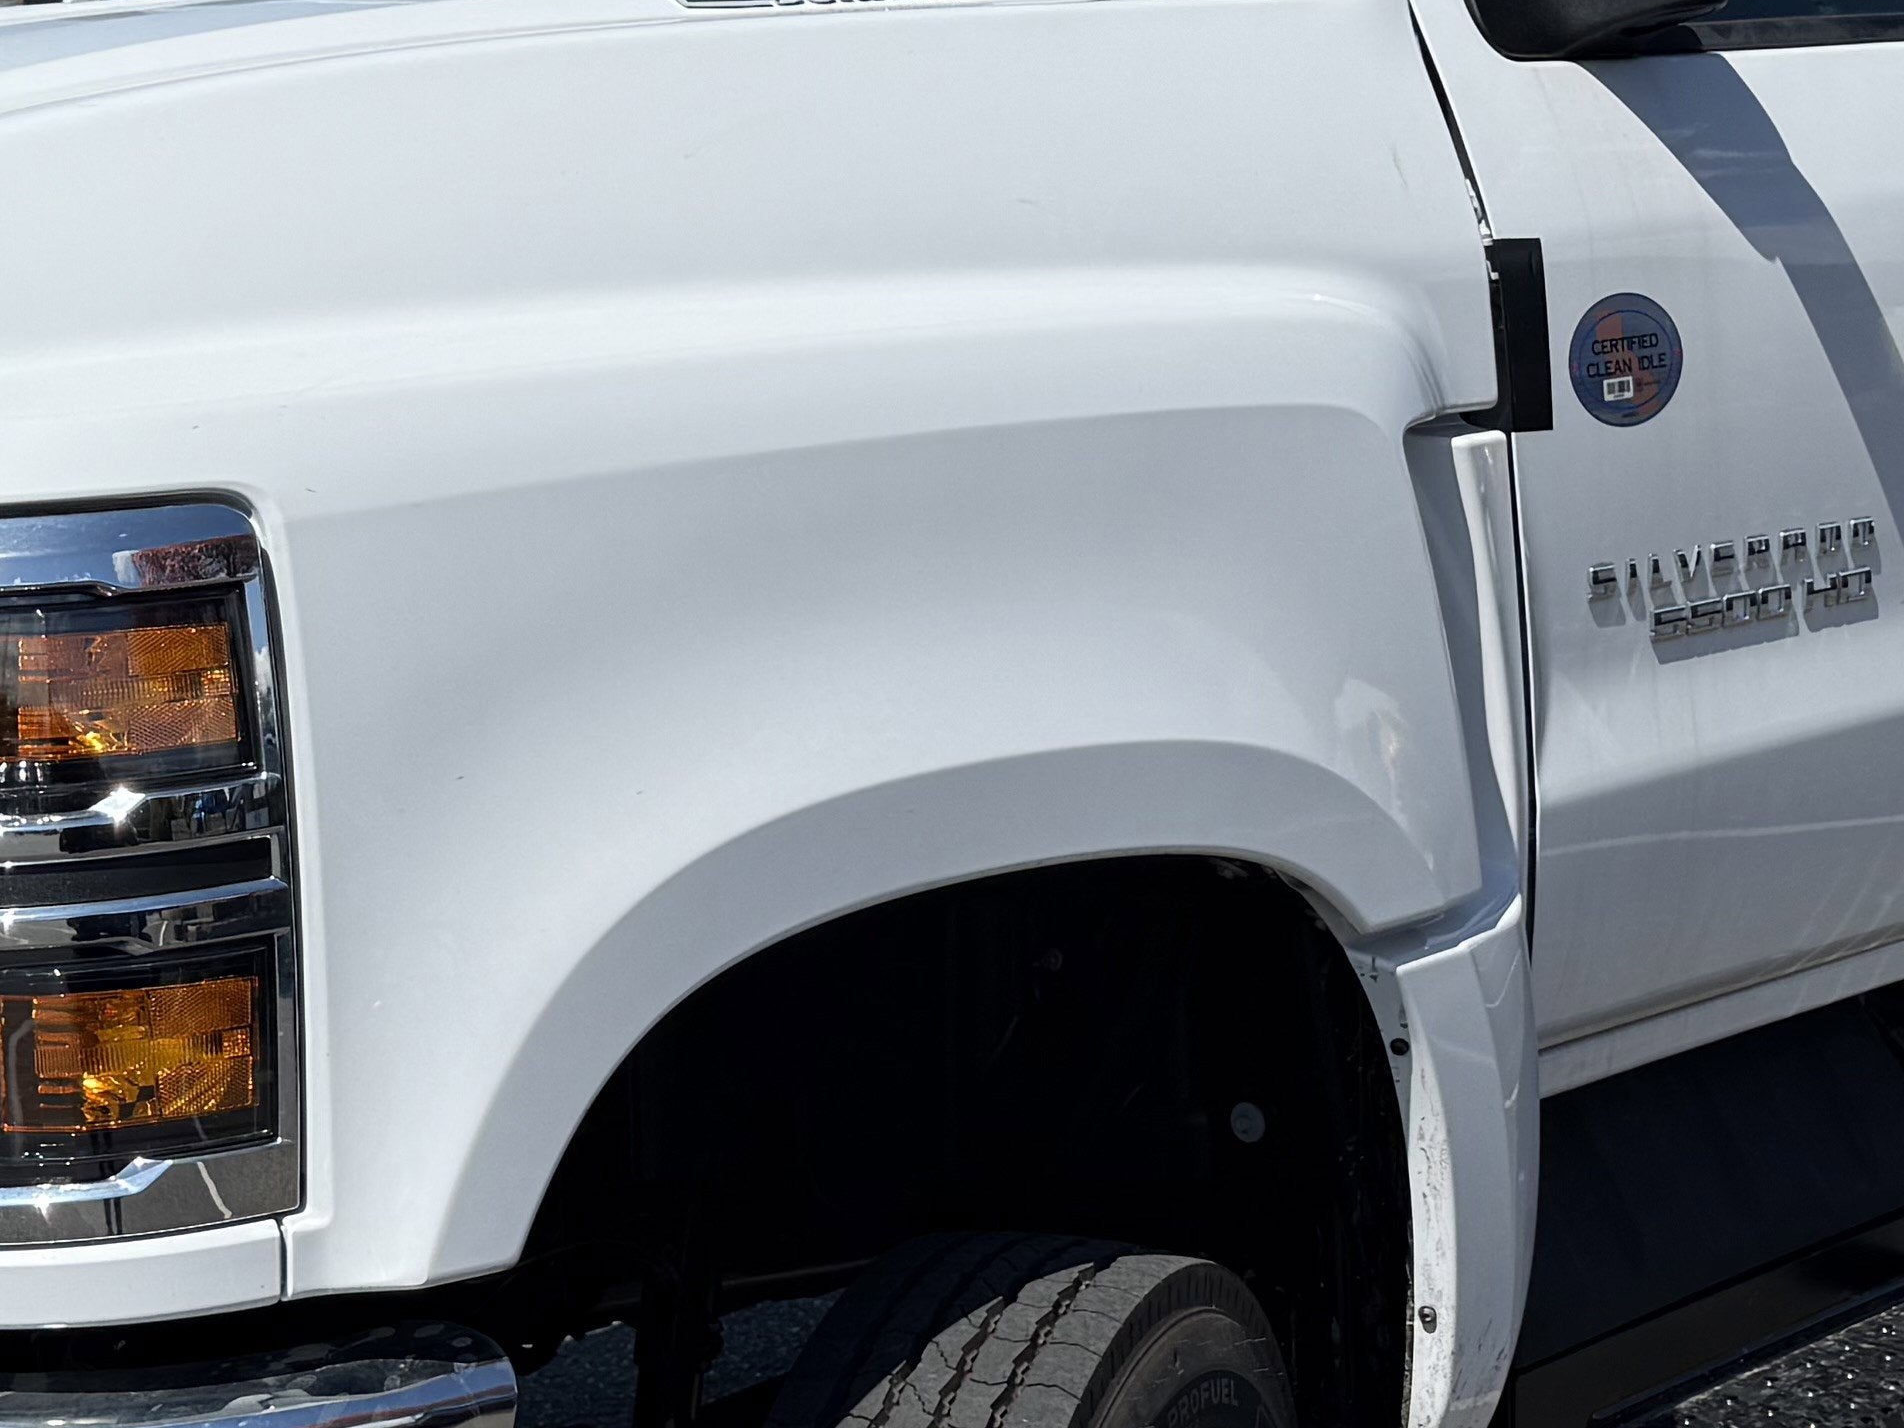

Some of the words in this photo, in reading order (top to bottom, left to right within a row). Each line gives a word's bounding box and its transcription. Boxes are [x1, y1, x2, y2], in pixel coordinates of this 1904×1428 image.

[1591, 333, 1660, 356] CERTIFIED
[1586, 358, 1633, 379] CLEAN
[1638, 353, 1668, 371] IDLE
[1587, 516, 1876, 603] SILVERADO
[1803, 567, 1873, 613] HD
